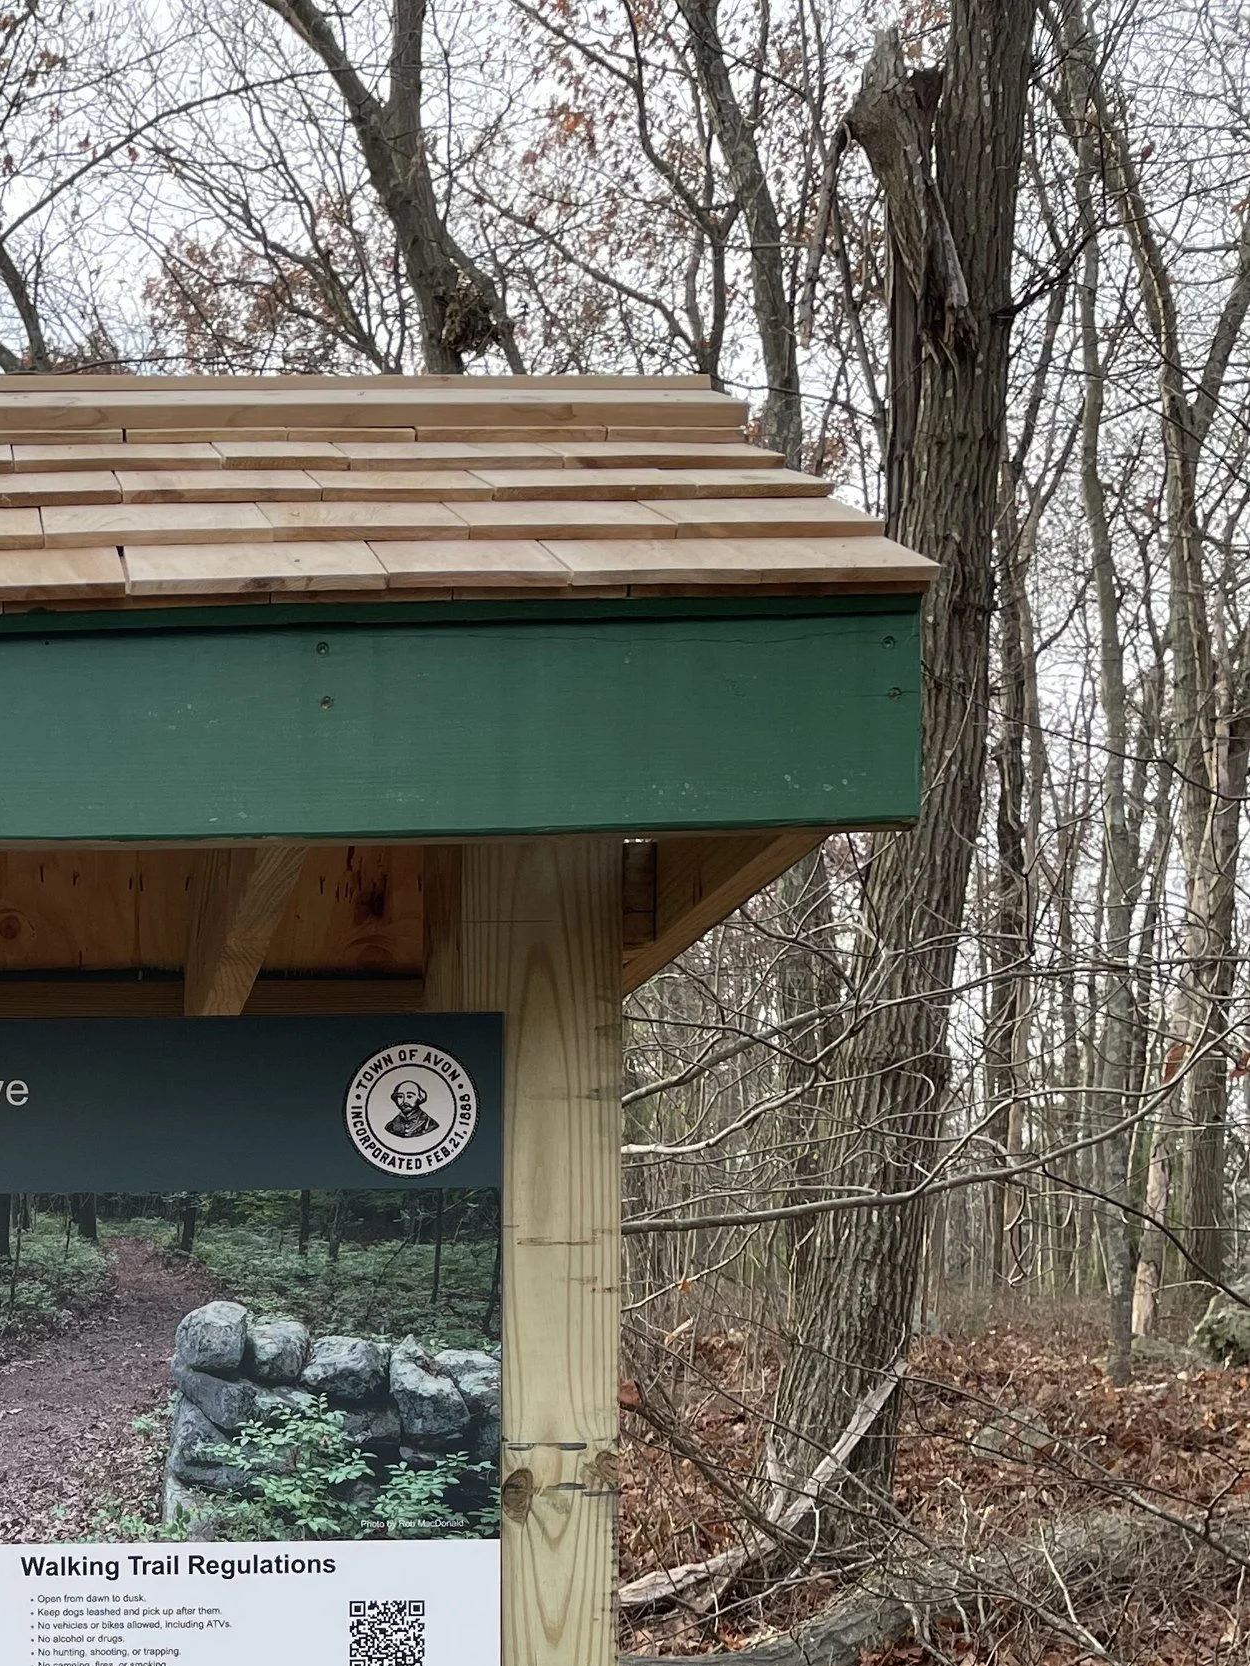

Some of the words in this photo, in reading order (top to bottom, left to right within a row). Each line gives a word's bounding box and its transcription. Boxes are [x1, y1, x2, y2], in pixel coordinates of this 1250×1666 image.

[356, 1054, 394, 1090] TOWN
[398, 1049, 418, 1061] OF
[423, 1052, 460, 1082] AVON
[20, 1556, 119, 1581] Walking
[127, 1555, 179, 1575] Trail
[188, 1554, 336, 1579] Regulations
[37, 1594, 61, 1604] Open
[63, 1594, 84, 1602] from
[85, 1594, 109, 1602] dawn
[111, 1594, 120, 1602] to
[122, 1593, 147, 1602] dusk.
[37, 1608, 60, 1617] Keep
[62, 1608, 84, 1618] dogs
[86, 1607, 121, 1616] leashed
[123, 1607, 140, 1615] and
[142, 1607, 160, 1617] pick
[162, 1608, 174, 1616] up
[175, 1606, 196, 1615] after
[197, 1606, 222, 1615] them.
[38, 1648, 50, 1656] No
[53, 1648, 87, 1658] hunting,
[90, 1647, 129, 1657] shooting,
[143, 1647, 180, 1657] trapping.
